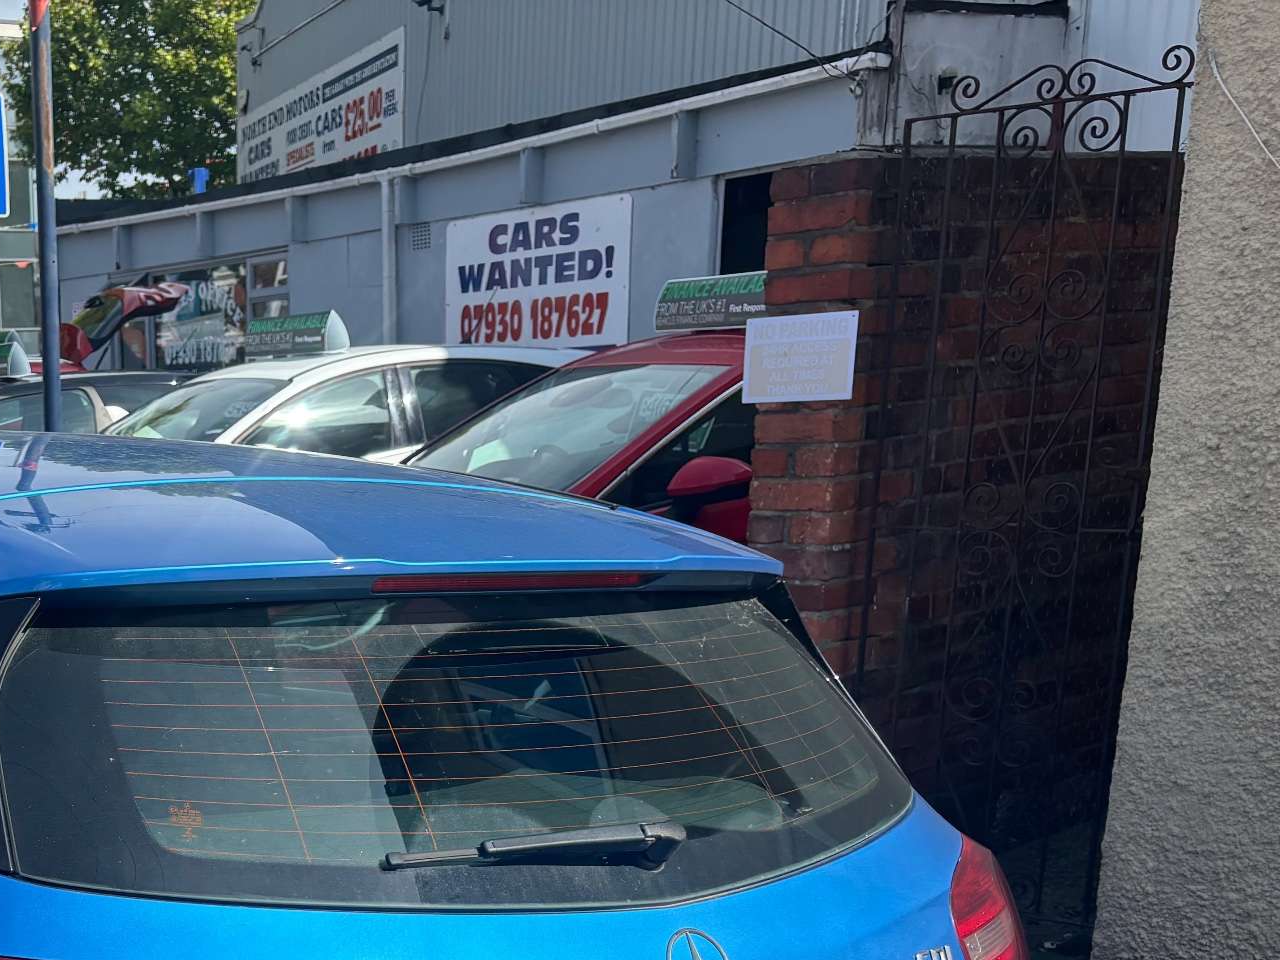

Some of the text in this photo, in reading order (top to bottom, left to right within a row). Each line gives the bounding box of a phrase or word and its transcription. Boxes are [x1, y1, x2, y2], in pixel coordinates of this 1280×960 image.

[286, 86, 320, 122] MOTORS
[316, 104, 343, 137] CARS
[345, 87, 382, 142] £25.00
[248, 136, 271, 165] CARS
[489, 212, 580, 255] CARS
[458, 245, 615, 294] WANTED!
[663, 274, 766, 299] FINANCE AVAILAB
[460, 291, 609, 344] 07930 187627
[656, 302, 679, 316] FROM
[680, 300, 695, 315] THE
[753, 318, 850, 341] NO PARKING
